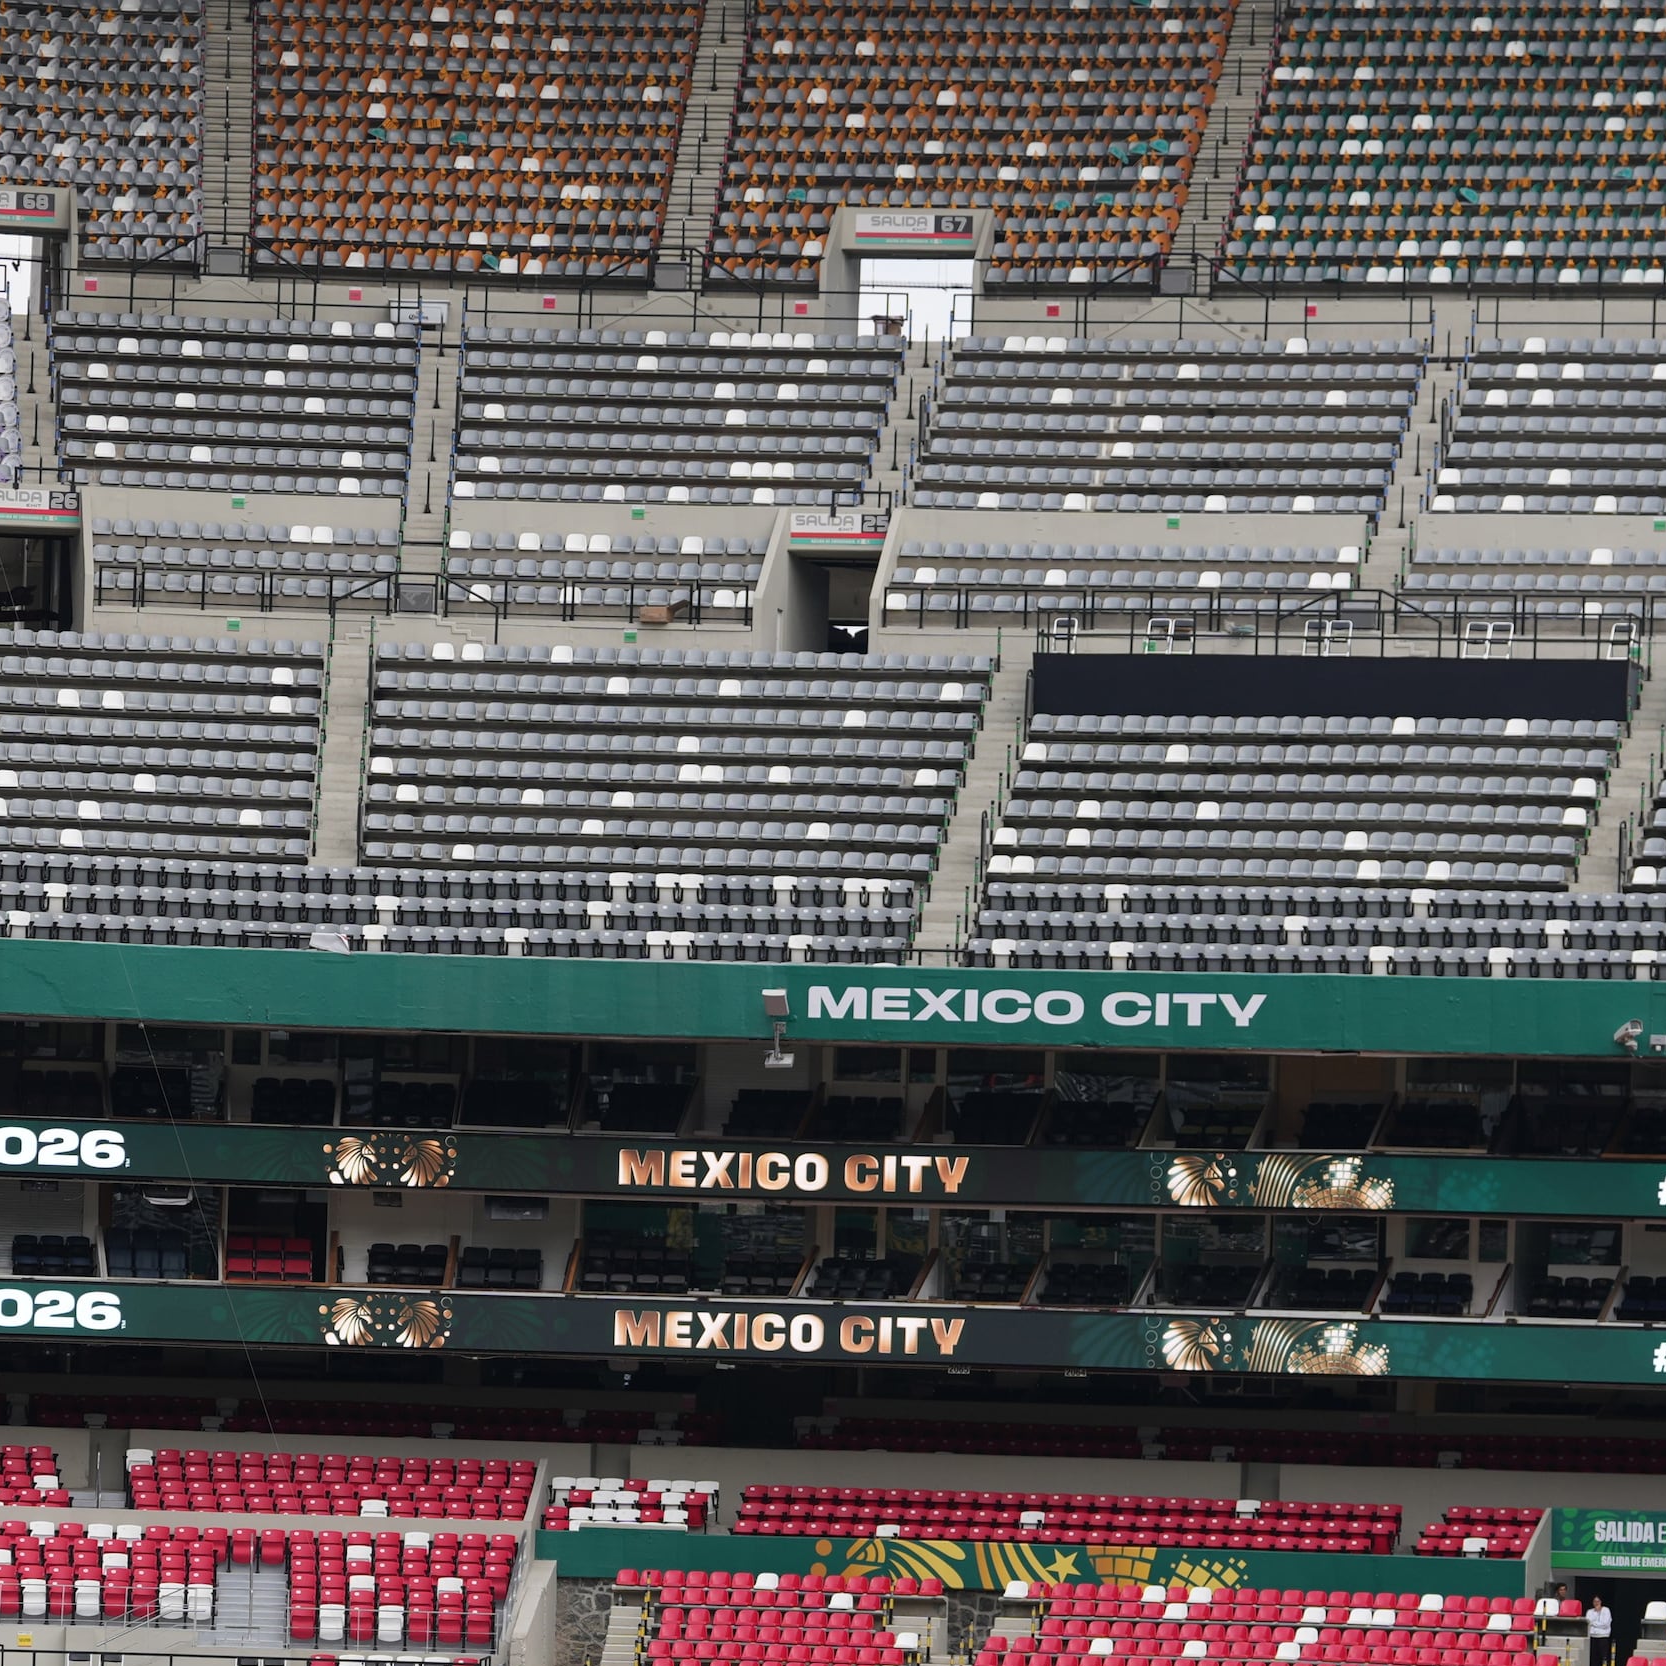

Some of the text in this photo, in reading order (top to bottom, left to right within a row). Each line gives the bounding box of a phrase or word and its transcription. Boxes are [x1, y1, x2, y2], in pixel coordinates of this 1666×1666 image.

[22, 193, 49, 209] 68
[870, 216, 967, 233] SALIDA 67
[49, 491, 79, 510] 26
[795, 515, 890, 533] SALIDA 25
[807, 985, 1268, 1027] MEXICO CITY
[618, 1148, 970, 1194] MEXICO CITY
[613, 1309, 965, 1355] MEXICO CITY
[1594, 1520, 1655, 1543] SALIDA
[1601, 1555, 1630, 1567] SALIDA
[1631, 1556, 1641, 1567] DE
